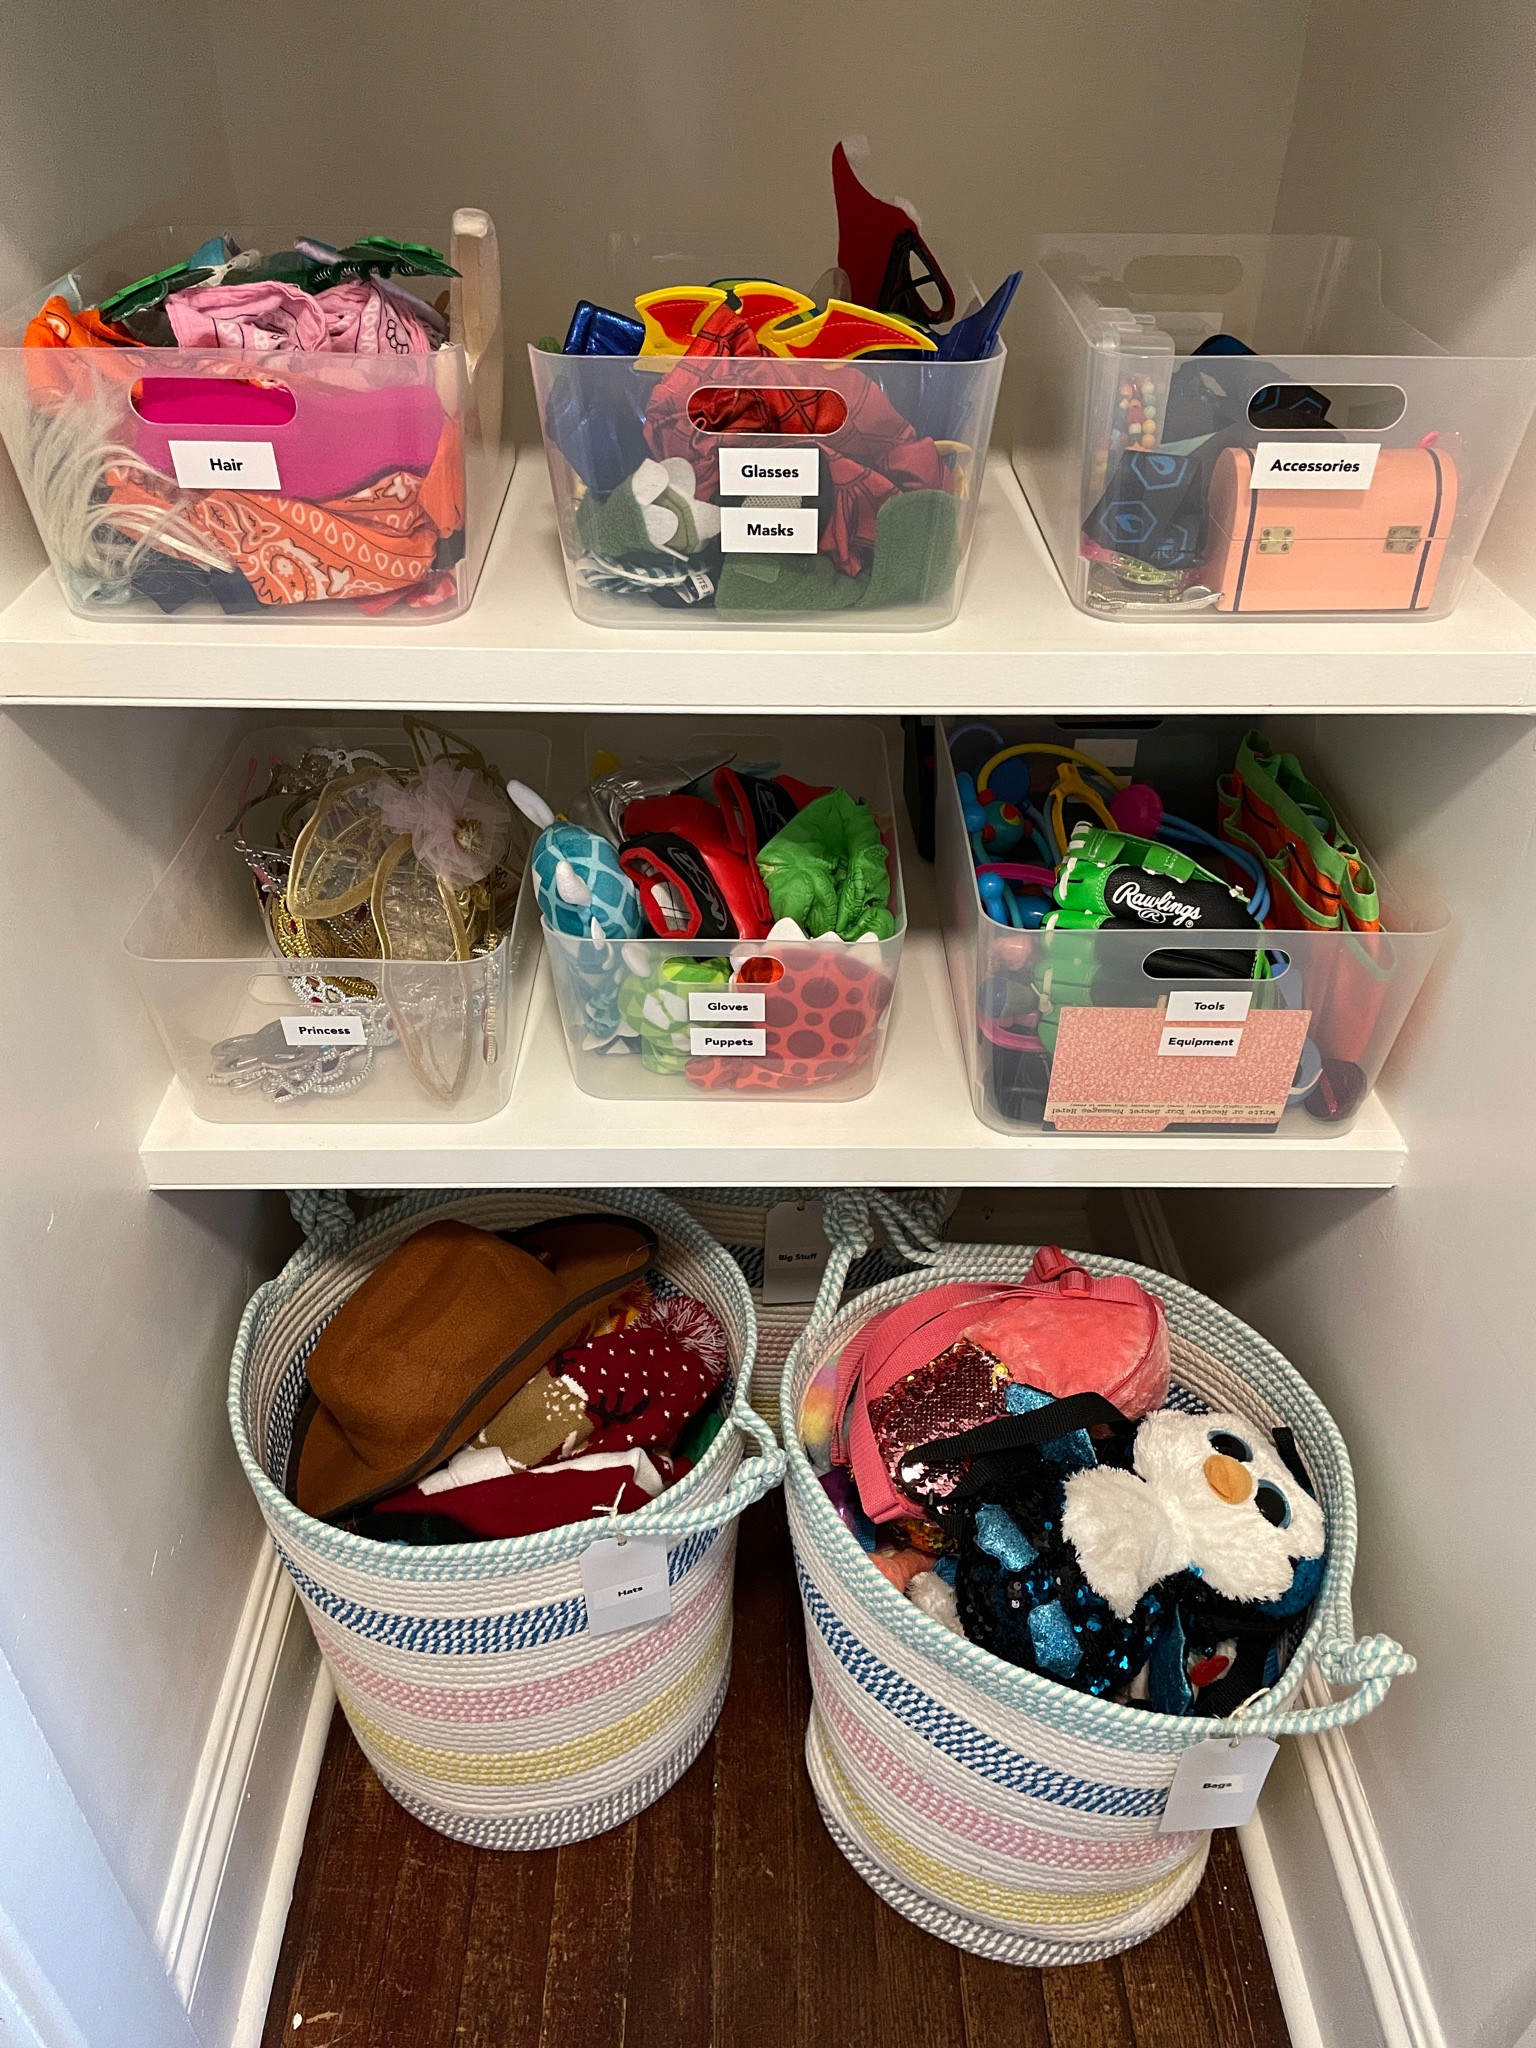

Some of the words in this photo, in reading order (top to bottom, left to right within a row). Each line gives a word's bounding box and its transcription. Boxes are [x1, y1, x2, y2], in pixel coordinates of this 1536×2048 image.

[209, 458, 244, 471] Hair
[1269, 458, 1360, 472] Accessories
[741, 464, 799, 478] Glasses
[747, 523, 794, 537] Masks
[1112, 881, 1202, 927] Rawlings
[707, 1002, 749, 1011] Gloves
[1194, 1001, 1226, 1011] Tools
[298, 1026, 351, 1035] Princess
[704, 1037, 754, 1048] Puppets
[1168, 1037, 1234, 1047] Equipment
[778, 1254, 793, 1262] Big
[795, 1252, 817, 1260] Stuff
[617, 1586, 643, 1597] Hats
